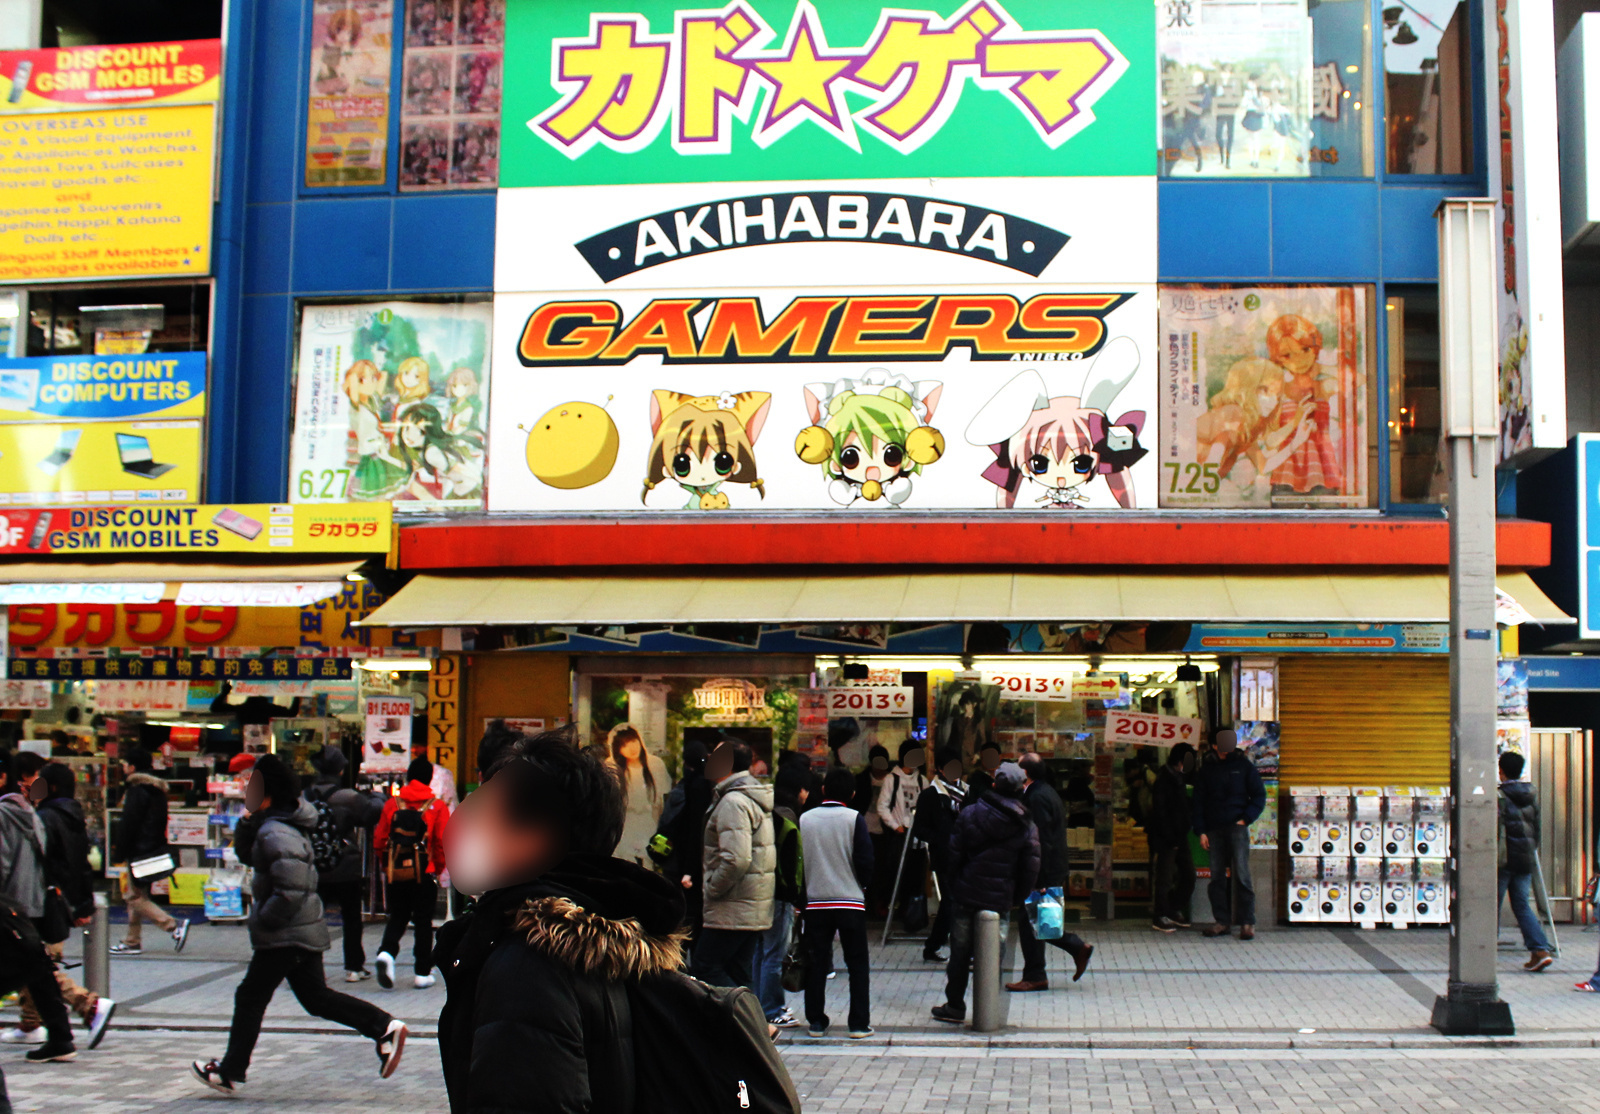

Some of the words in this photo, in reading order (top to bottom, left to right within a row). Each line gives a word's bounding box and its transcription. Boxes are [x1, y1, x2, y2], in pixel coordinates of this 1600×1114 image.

[56, 45, 183, 69] DISCOUNT
[36, 71, 91, 91] GSM
[96, 64, 205, 88] MOBILES
[3, 116, 106, 132] OVERSEAS
[114, 114, 149, 127] USE
[37, 133, 90, 145] Visual
[100, 158, 184, 170] Suitcases
[56, 191, 91, 203] and
[78, 201, 162, 214] Souvenirs
[116, 214, 182, 226] Katana
[634, 194, 1008, 266] AKIHABARA
[24, 233, 64, 245] Dolls
[62, 248, 99, 260] Staff
[104, 246, 189, 258] Members
[94, 258, 179, 271] available
[517, 292, 1138, 367] GAMERS
[1010, 351, 1084, 362] ANIBRO
[51, 360, 178, 381] DISCOUNT
[40, 381, 191, 403] COMPUTERS
[298, 469, 350, 499] 6.27
[1164, 462, 1220, 494] 7.25
[71, 508, 197, 527] DISCOUNT
[308, 522, 379, 537] タカラダ
[49, 530, 100, 549] GSM
[110, 529, 219, 548] MOBILES
[1544, 669, 1560, 677] Site
[992, 676, 1049, 693] 2013
[431, 657, 455, 743] DUTY
[832, 693, 890, 709] 2013
[367, 702, 379, 715] B1
[381, 702, 411, 716] FLOOR
[1115, 718, 1176, 739] 2013
